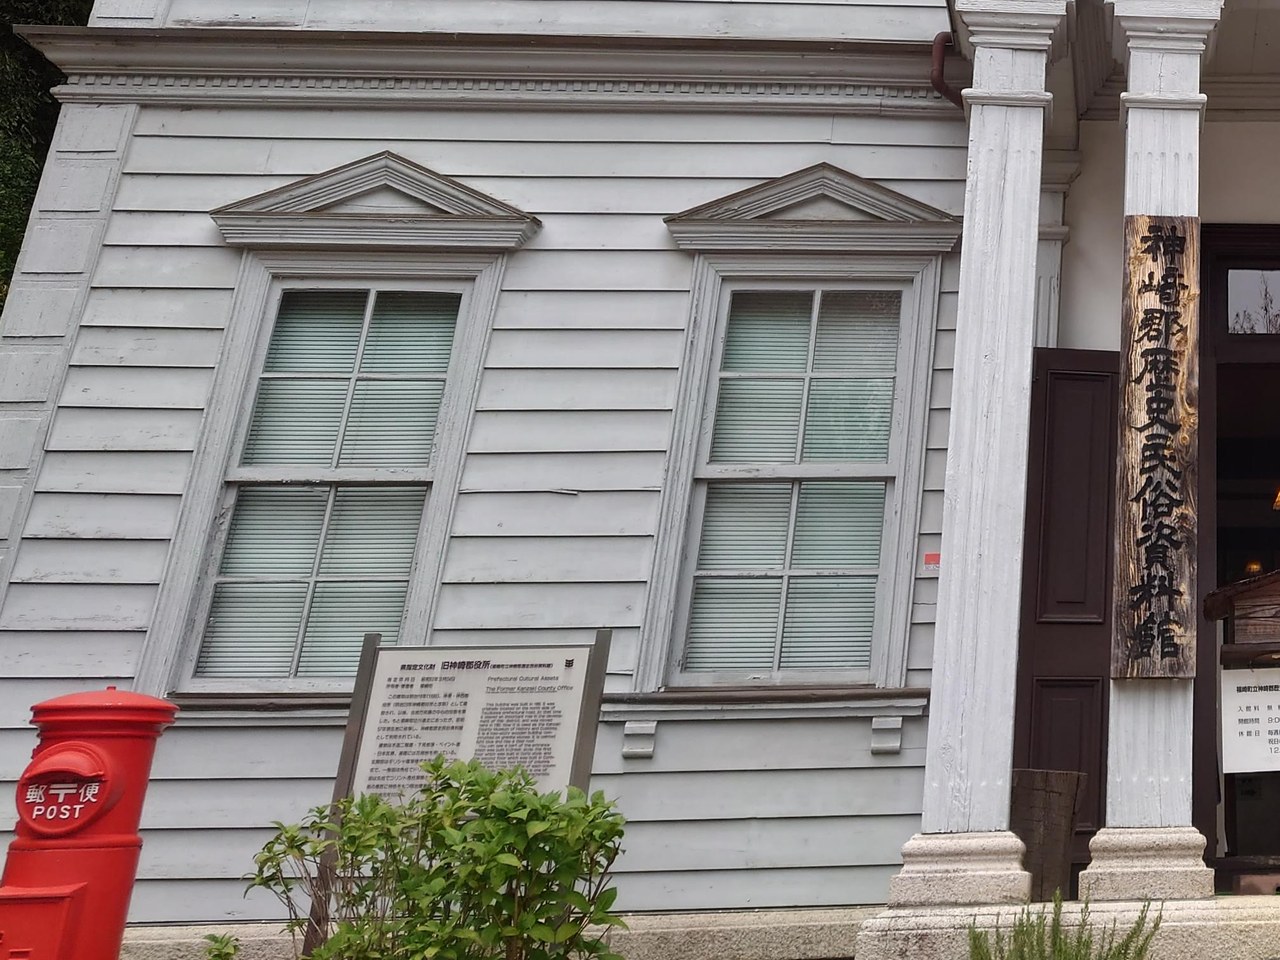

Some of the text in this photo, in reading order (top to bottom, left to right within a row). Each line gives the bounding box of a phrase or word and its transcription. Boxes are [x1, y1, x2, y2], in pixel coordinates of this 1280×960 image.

[1129, 225, 1188, 659] 神崎郡歴史民俗資料館
[32, 804, 85, 820] POST
